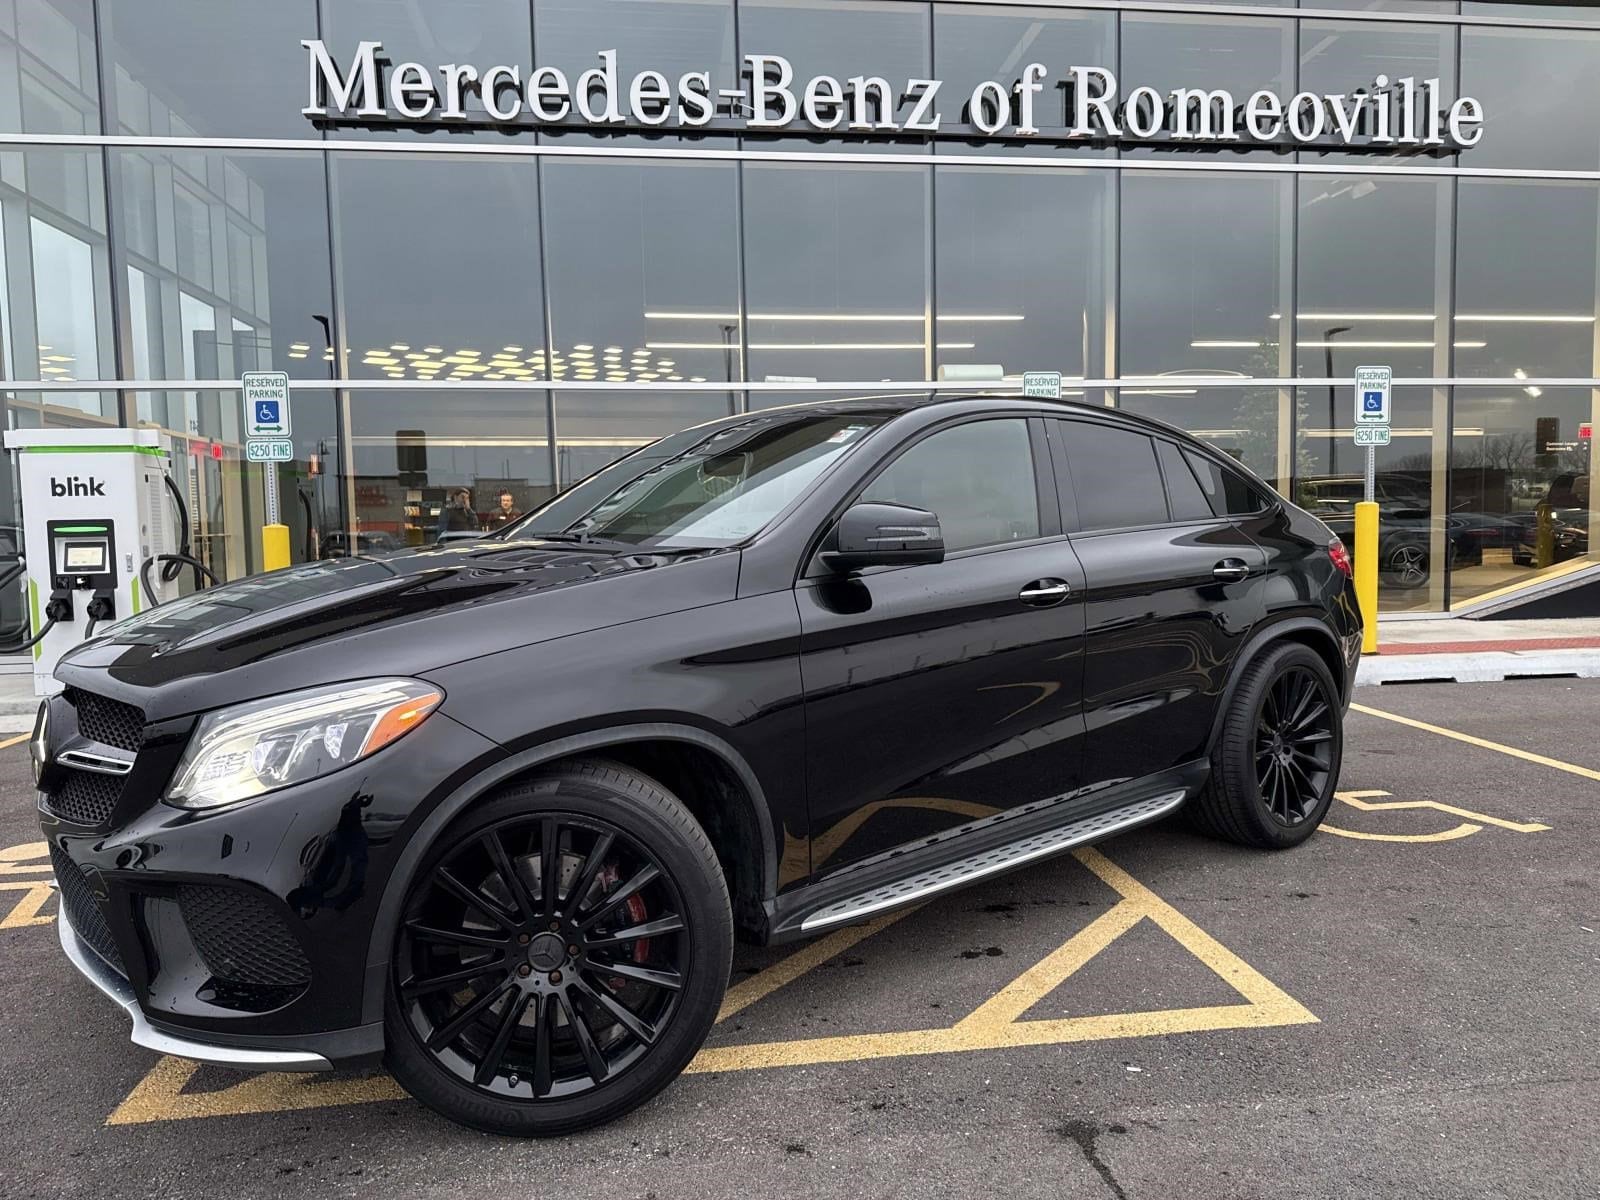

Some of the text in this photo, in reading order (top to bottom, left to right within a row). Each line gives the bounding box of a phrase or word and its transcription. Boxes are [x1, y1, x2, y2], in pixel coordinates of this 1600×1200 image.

[301, 39, 1484, 146] Mercedes-Benz of Romeoville
[1358, 372, 1389, 380] RESERVED
[246, 378, 285, 388] RESERVED
[1025, 378, 1059, 386] RESERVED
[1360, 382, 1387, 390] PARKING
[249, 389, 283, 399] PARKING
[1027, 388, 1057, 397] PARKING
[1357, 430, 1388, 441] $250 FINE
[250, 444, 290, 457] $250 FINE
[51, 477, 106, 497] blink
